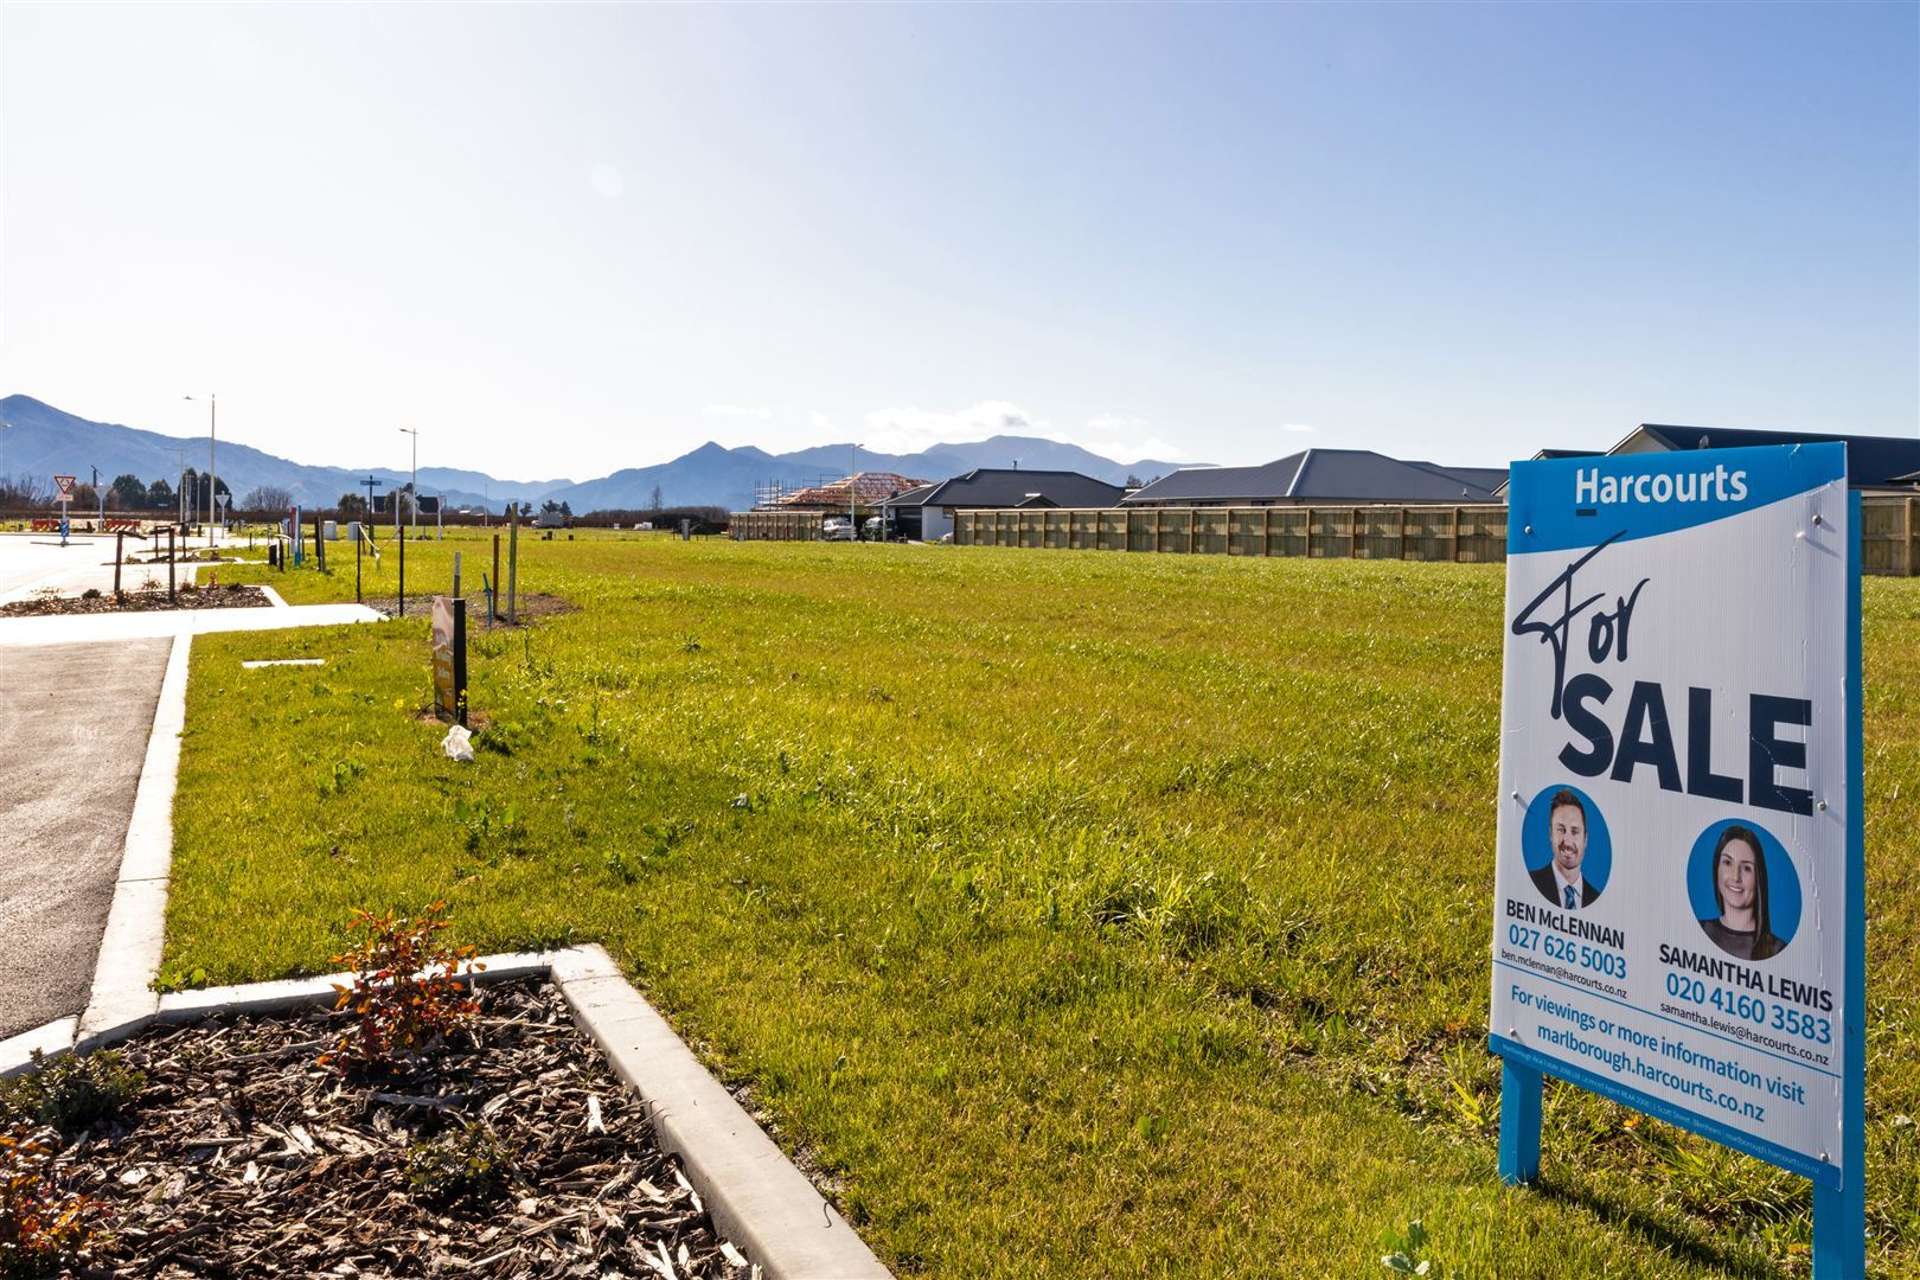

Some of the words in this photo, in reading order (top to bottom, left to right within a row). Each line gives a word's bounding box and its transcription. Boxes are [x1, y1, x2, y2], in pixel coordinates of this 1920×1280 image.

[1575, 463, 1749, 504] Harcourts
[1511, 529, 1651, 720] For
[1557, 673, 1814, 817] SALE
[1506, 898, 1536, 924] BEN
[1539, 907, 1625, 951] McLENNAN
[1509, 924, 1540, 951] 027
[1543, 935, 1577, 964] 626
[1580, 945, 1627, 980] 5003
[1501, 948, 1628, 999] ben.mclennan@harcourts.co.nz
[1658, 943, 1765, 993] SAMANTHA
[1768, 974, 1833, 1012] LEWIS
[1660, 1002, 1829, 1066] samantha.lewis@harcourts.co.nz
[1666, 972, 1706, 1005] 020
[1709, 987, 1766, 1024] 4160
[1770, 1004, 1832, 1045] 3583
[1511, 985, 1534, 1006] For
[1535, 995, 1596, 1031] viewings
[1599, 1019, 1615, 1035] or
[1617, 1026, 1658, 1052] more
[1661, 1036, 1762, 1089] information
[1765, 1077, 1805, 1105] visit
[1537, 1025, 1766, 1122] marlborough.harcourts.co.nz
